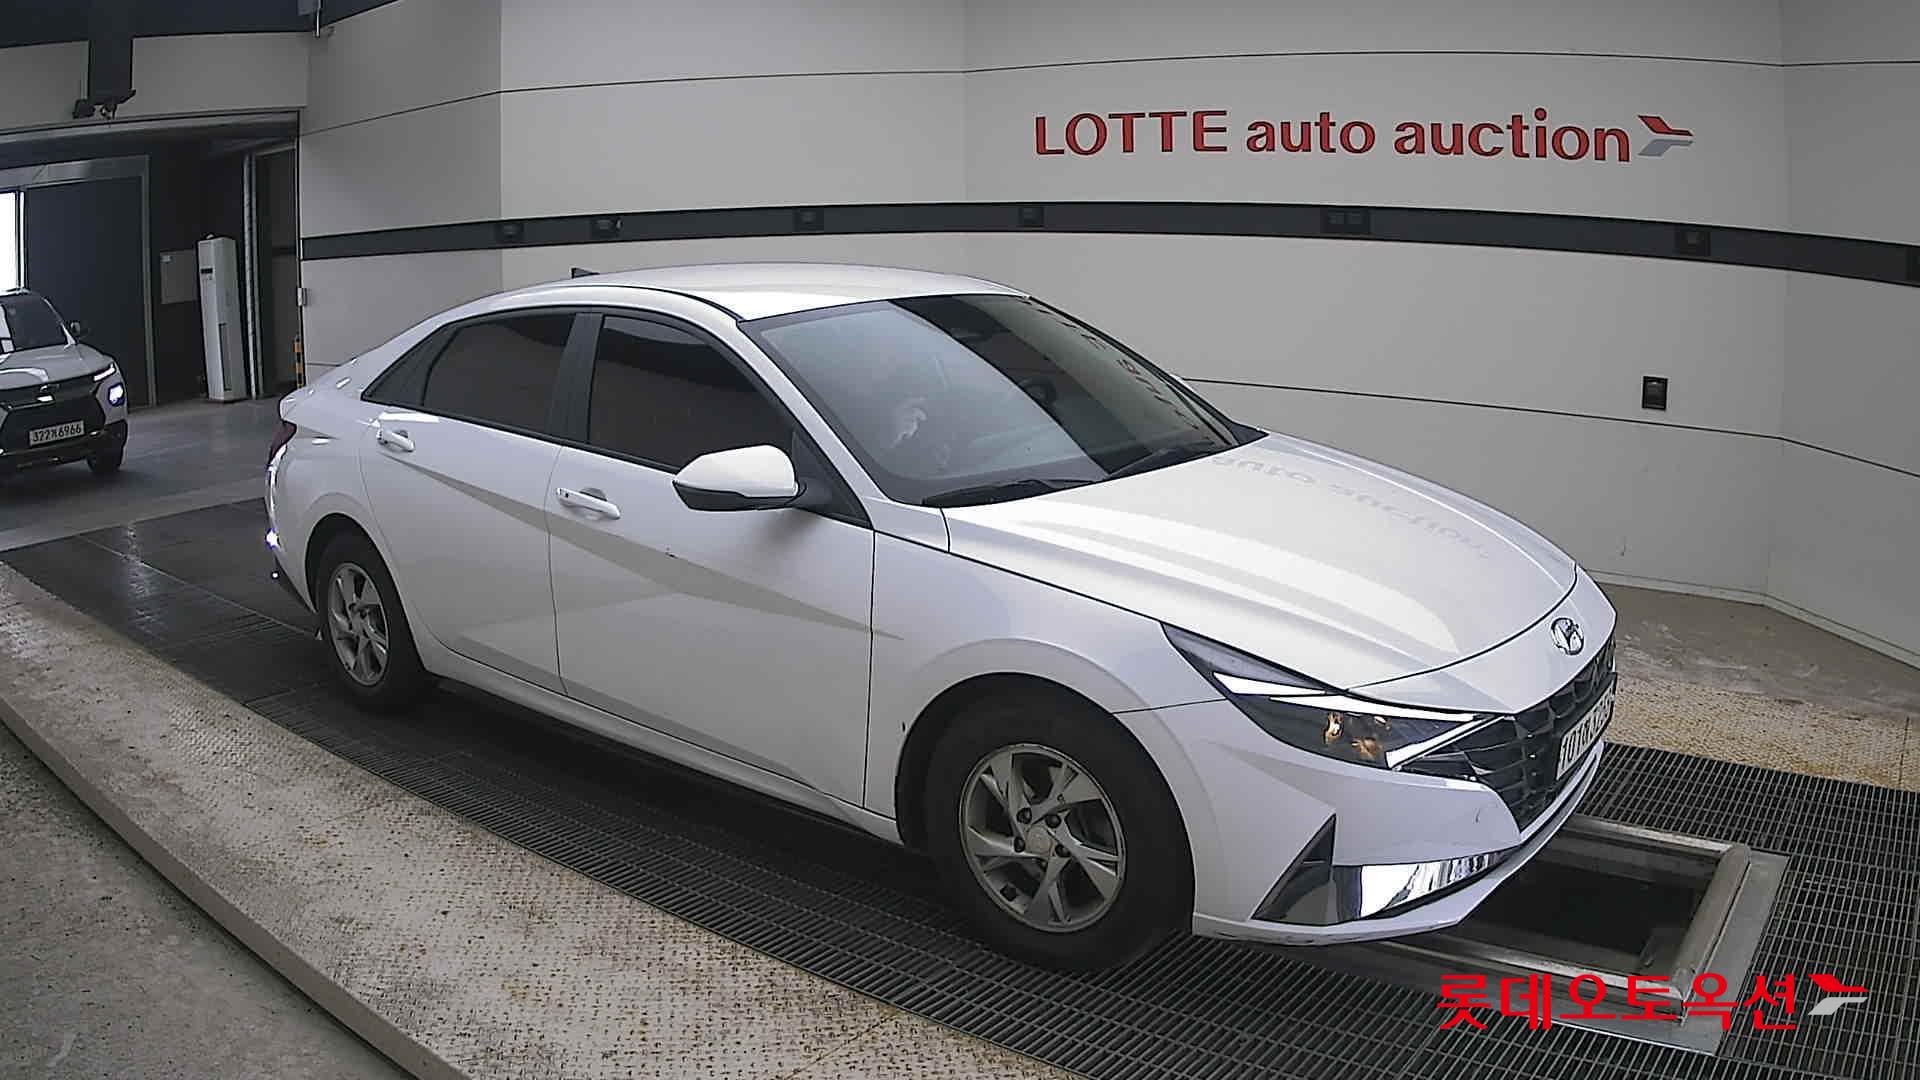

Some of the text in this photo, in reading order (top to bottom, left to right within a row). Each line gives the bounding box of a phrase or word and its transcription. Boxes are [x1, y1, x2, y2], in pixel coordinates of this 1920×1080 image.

[1035, 107, 1631, 163] LOTTE auto auction
